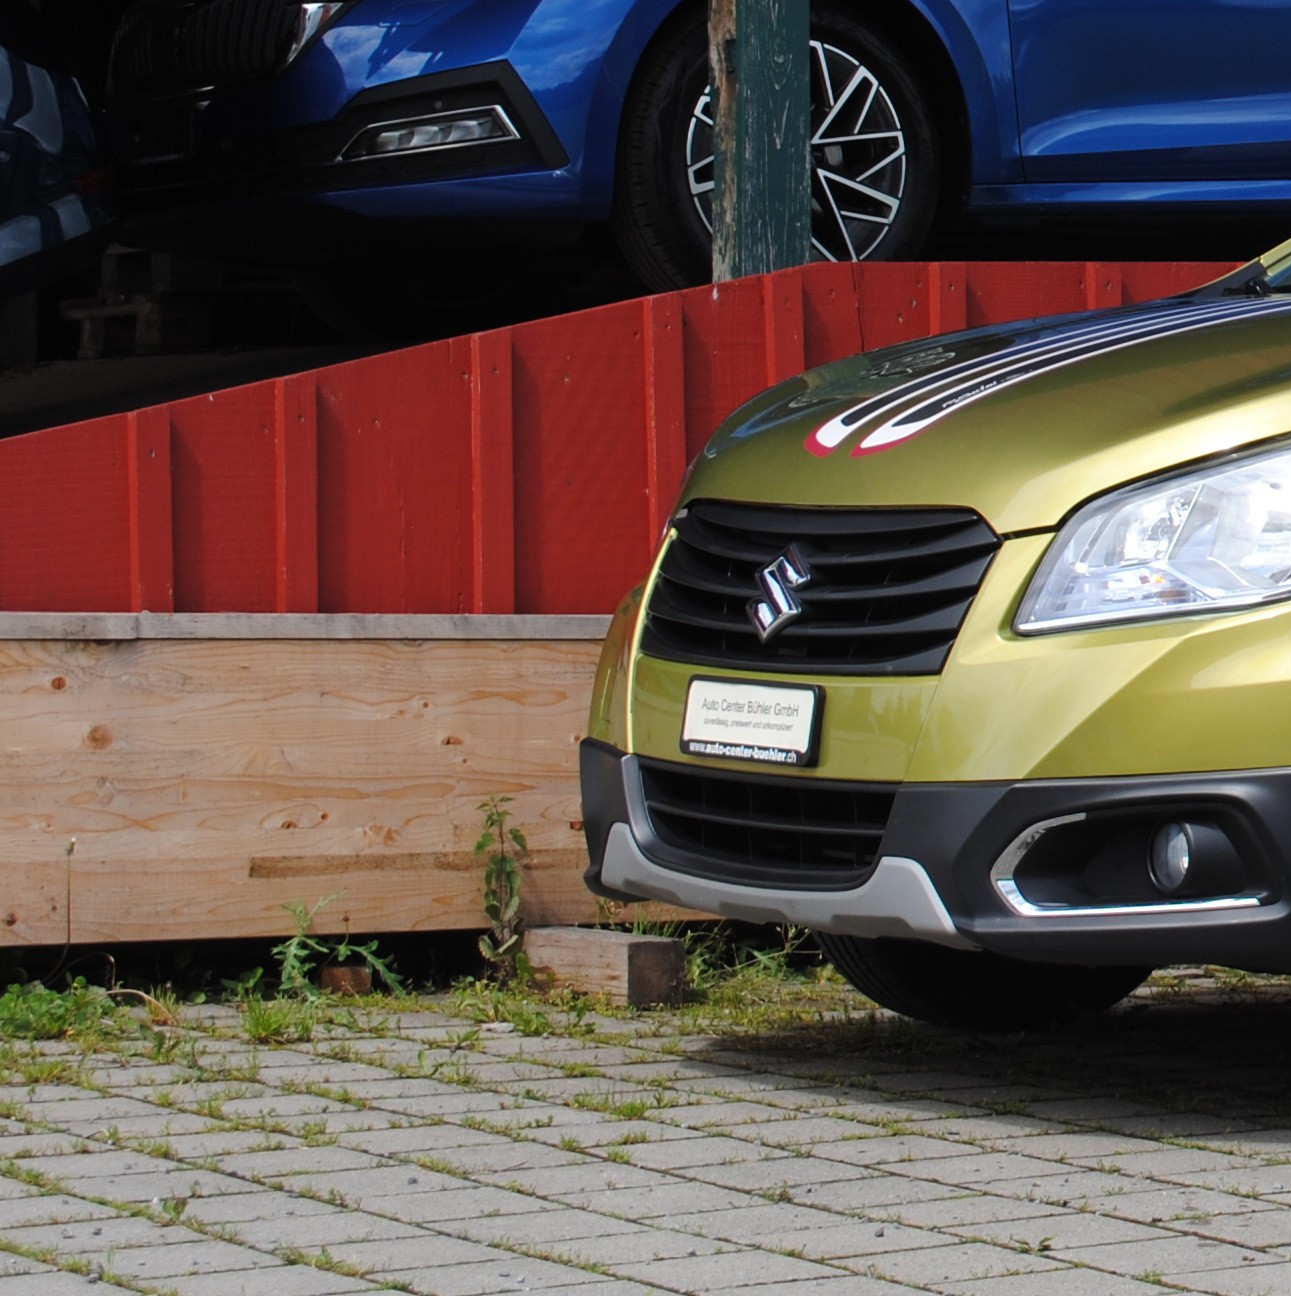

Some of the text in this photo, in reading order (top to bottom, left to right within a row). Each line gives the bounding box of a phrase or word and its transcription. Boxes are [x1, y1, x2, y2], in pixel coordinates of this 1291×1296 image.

[702, 697, 800, 718] Auto Center Bühler GmbH
[689, 742, 796, 763] www.auto-center-buehler.ch
